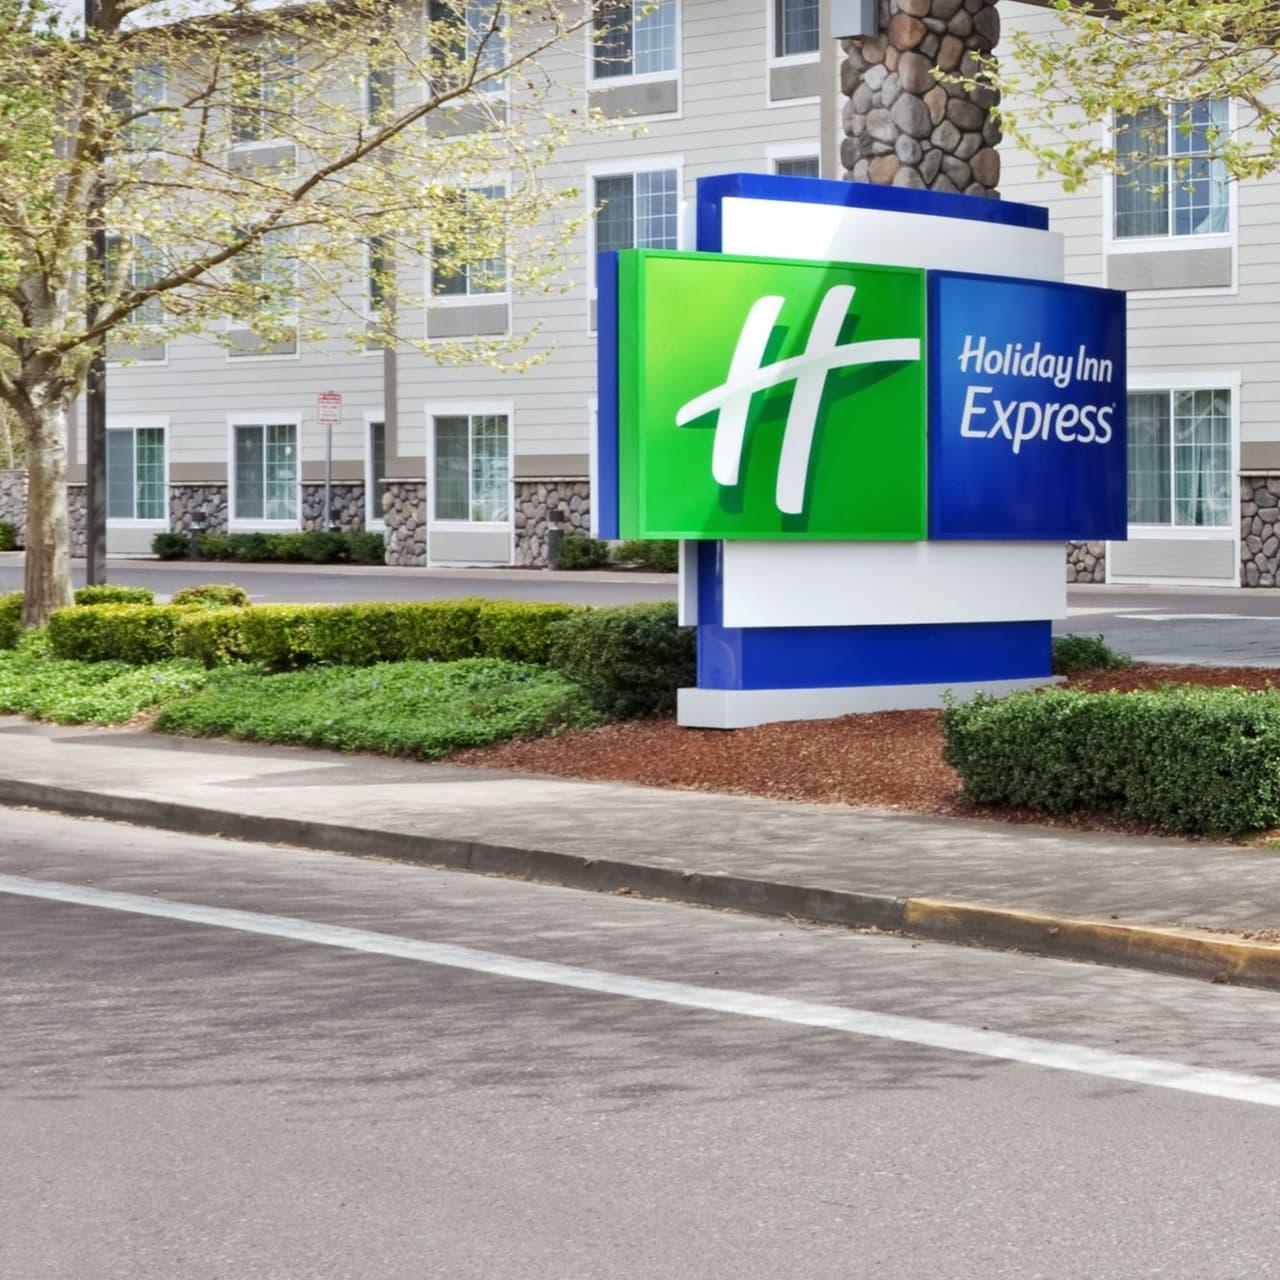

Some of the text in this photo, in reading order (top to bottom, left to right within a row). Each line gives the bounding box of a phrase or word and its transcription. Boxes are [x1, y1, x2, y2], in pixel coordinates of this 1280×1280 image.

[958, 335, 1113, 388] Holiday Inn
[960, 385, 1114, 455] Express
